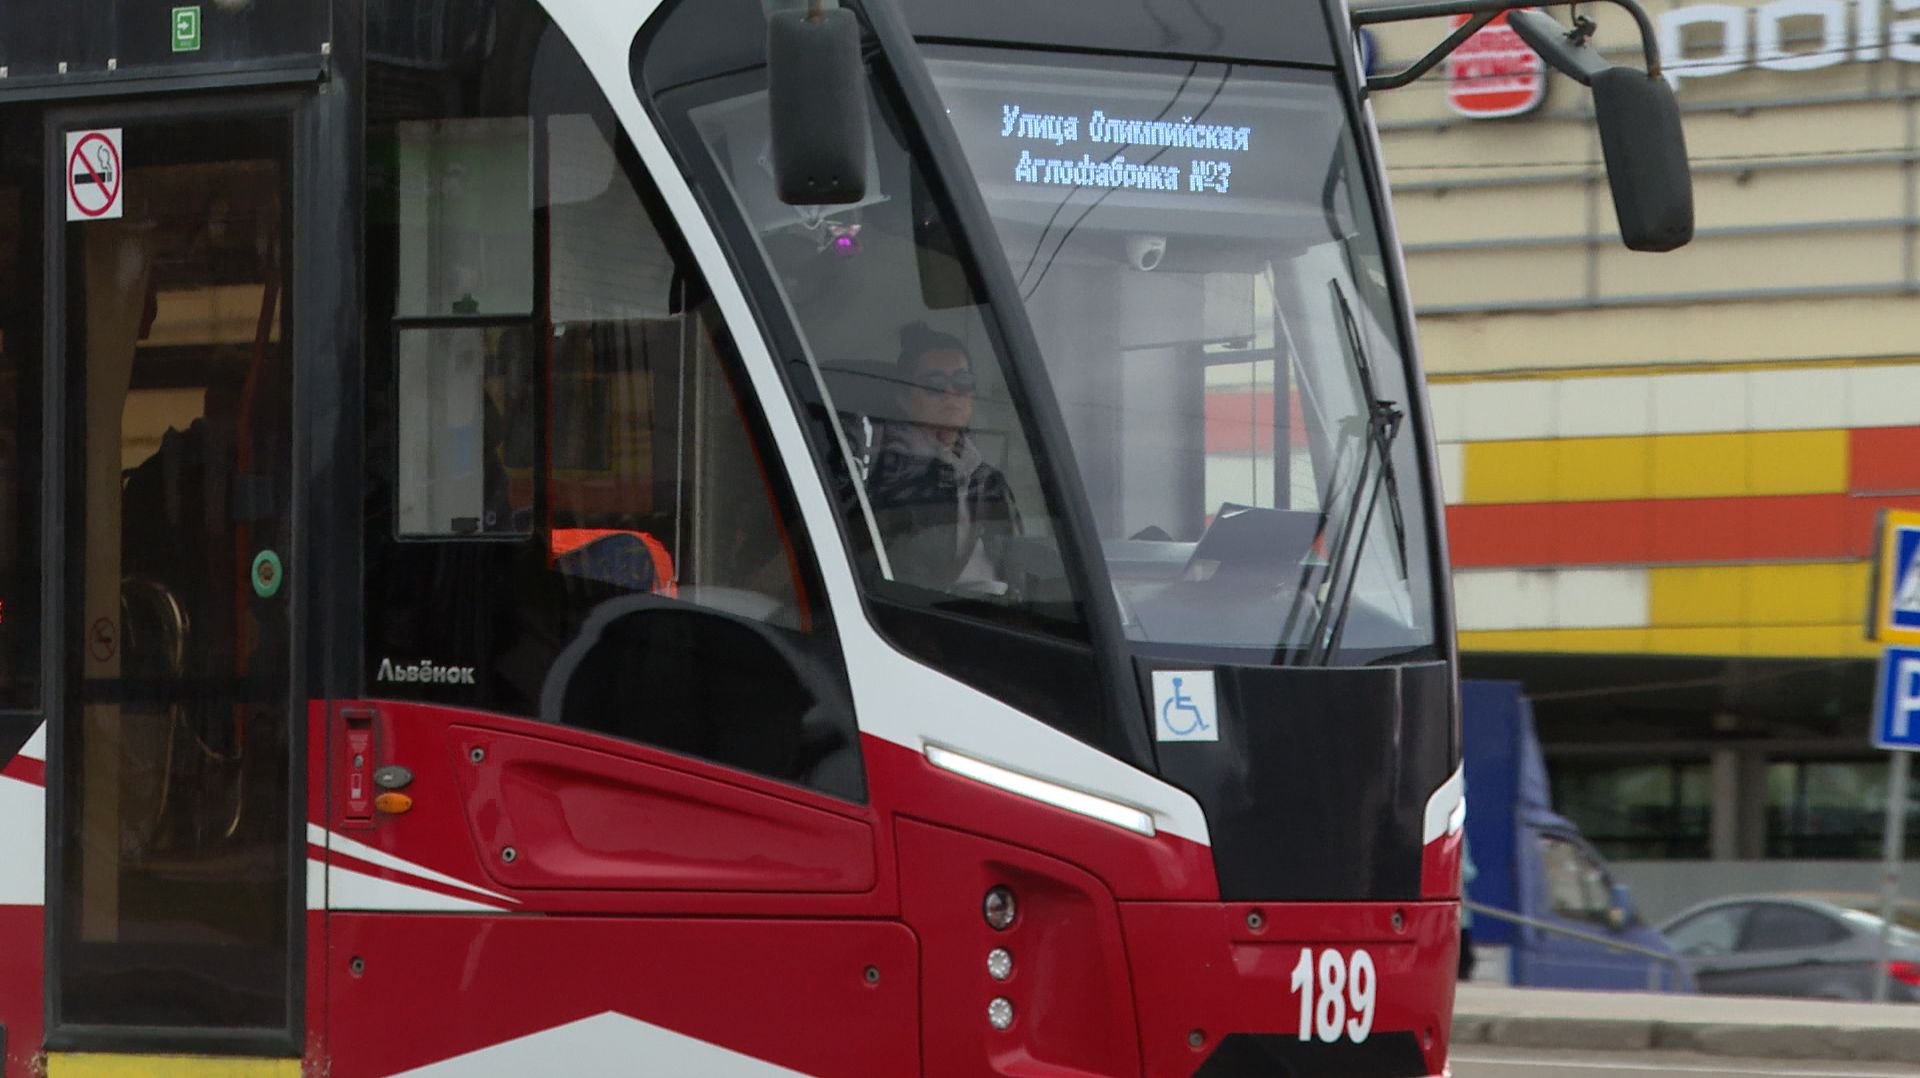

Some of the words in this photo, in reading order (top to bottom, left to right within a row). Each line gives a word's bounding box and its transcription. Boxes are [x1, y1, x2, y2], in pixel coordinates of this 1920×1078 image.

[1001, 104, 1079, 145] Улица
[1089, 110, 1251, 151] Олимпийская
[1015, 150, 1180, 190] Аглофабрика
[1189, 160, 1232, 193] №3
[377, 658, 476, 684] Львёнок
[1291, 947, 1377, 1044] 189
